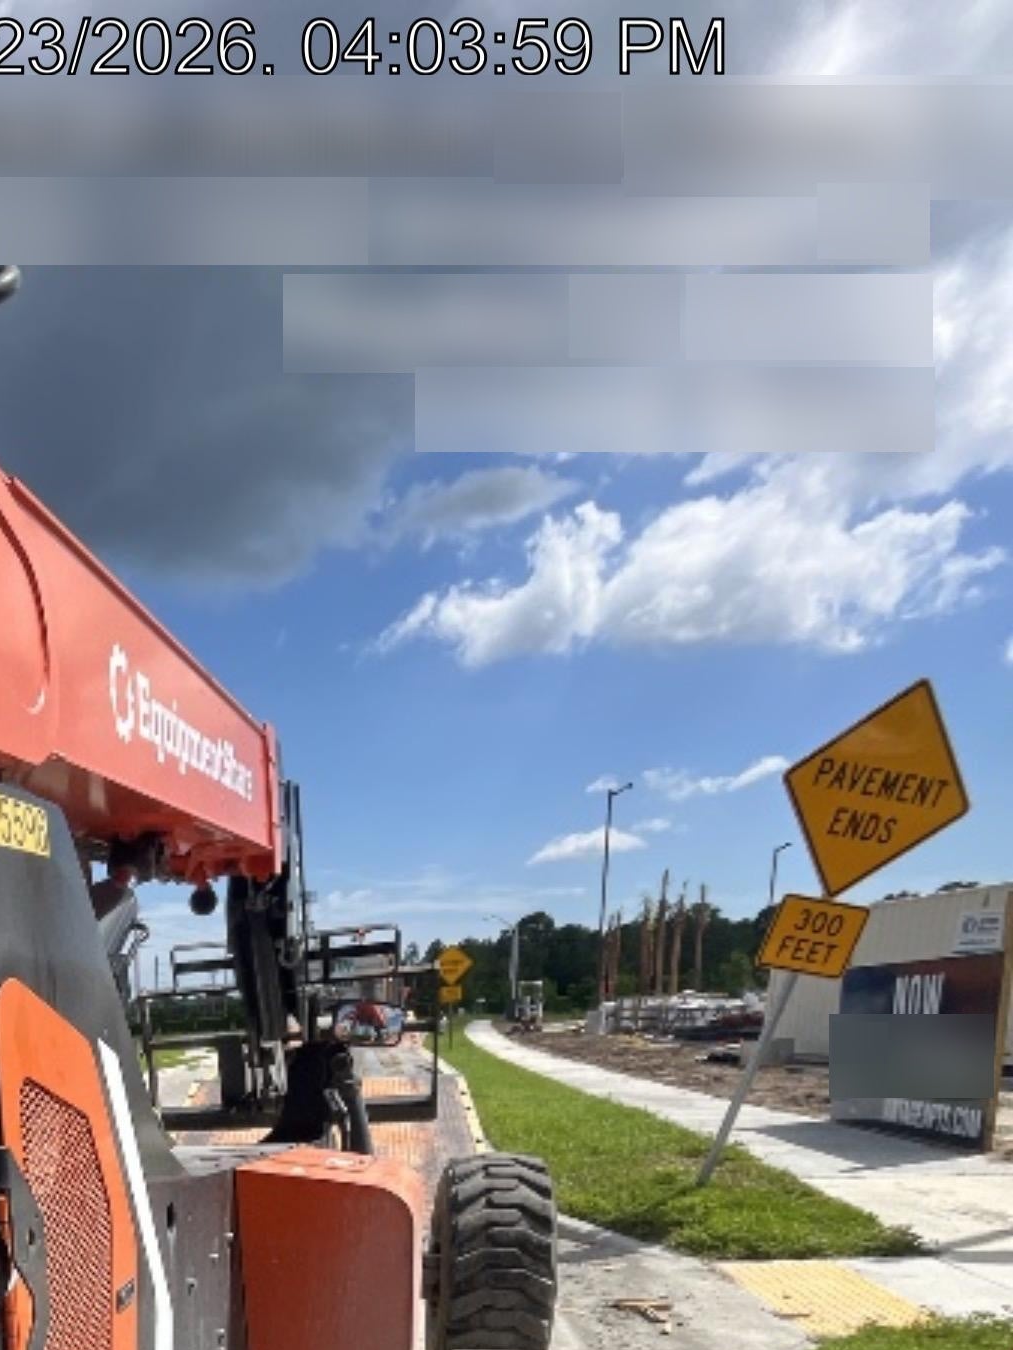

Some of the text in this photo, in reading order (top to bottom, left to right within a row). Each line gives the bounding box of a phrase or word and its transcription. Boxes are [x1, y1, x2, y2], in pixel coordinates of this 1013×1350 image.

[812, 757, 950, 809] PAVEMENT
[827, 807, 898, 844] ENDS
[793, 908, 845, 936] 300
[776, 935, 839, 965] FEET
